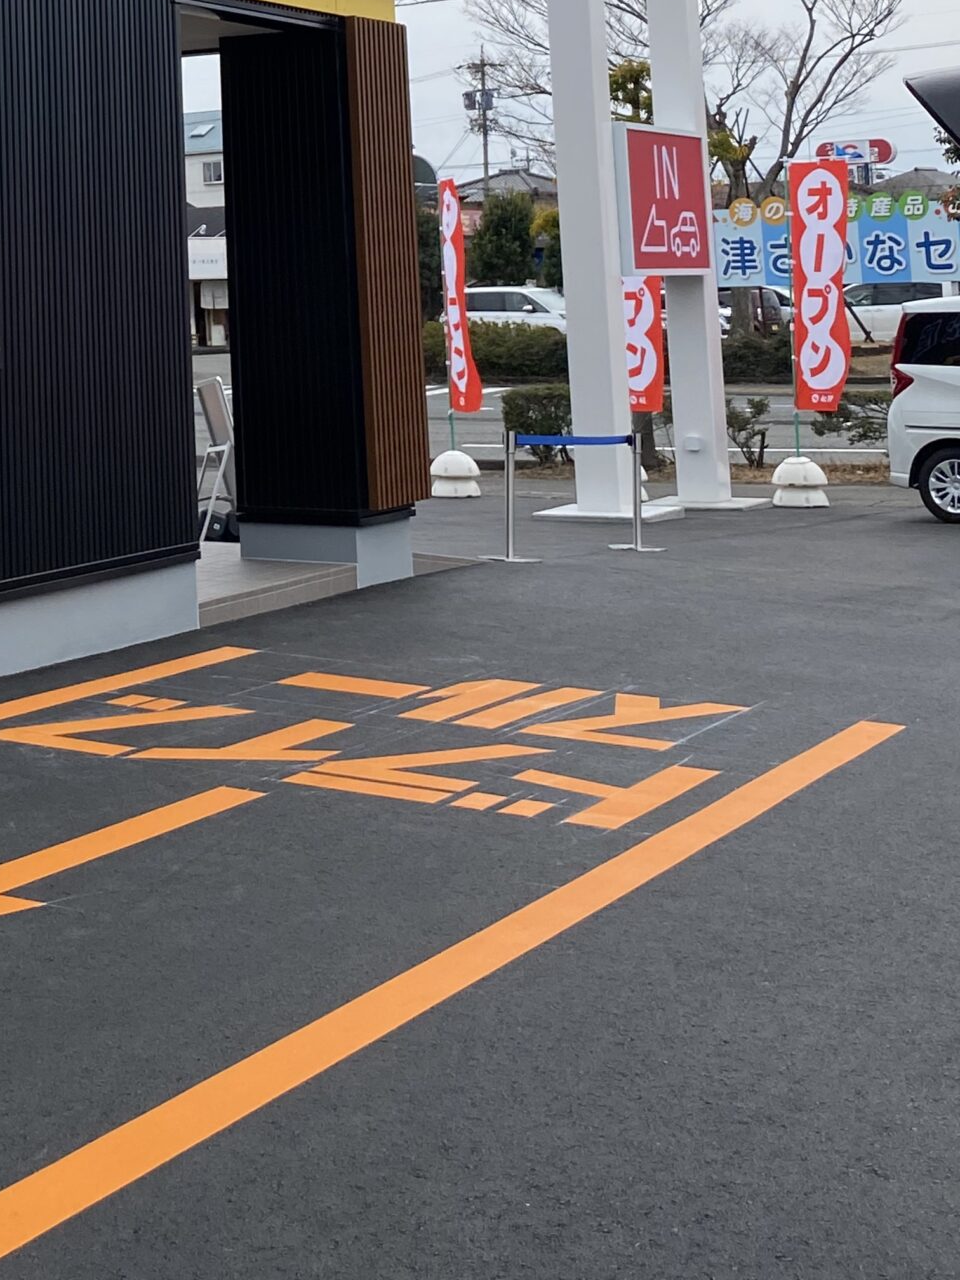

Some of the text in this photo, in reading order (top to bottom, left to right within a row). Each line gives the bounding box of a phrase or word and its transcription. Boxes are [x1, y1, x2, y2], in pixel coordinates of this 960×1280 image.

[653, 144, 680, 201] IN
[721, 231, 954, 277] 津さなセ
[806, 180, 832, 378] オープン
